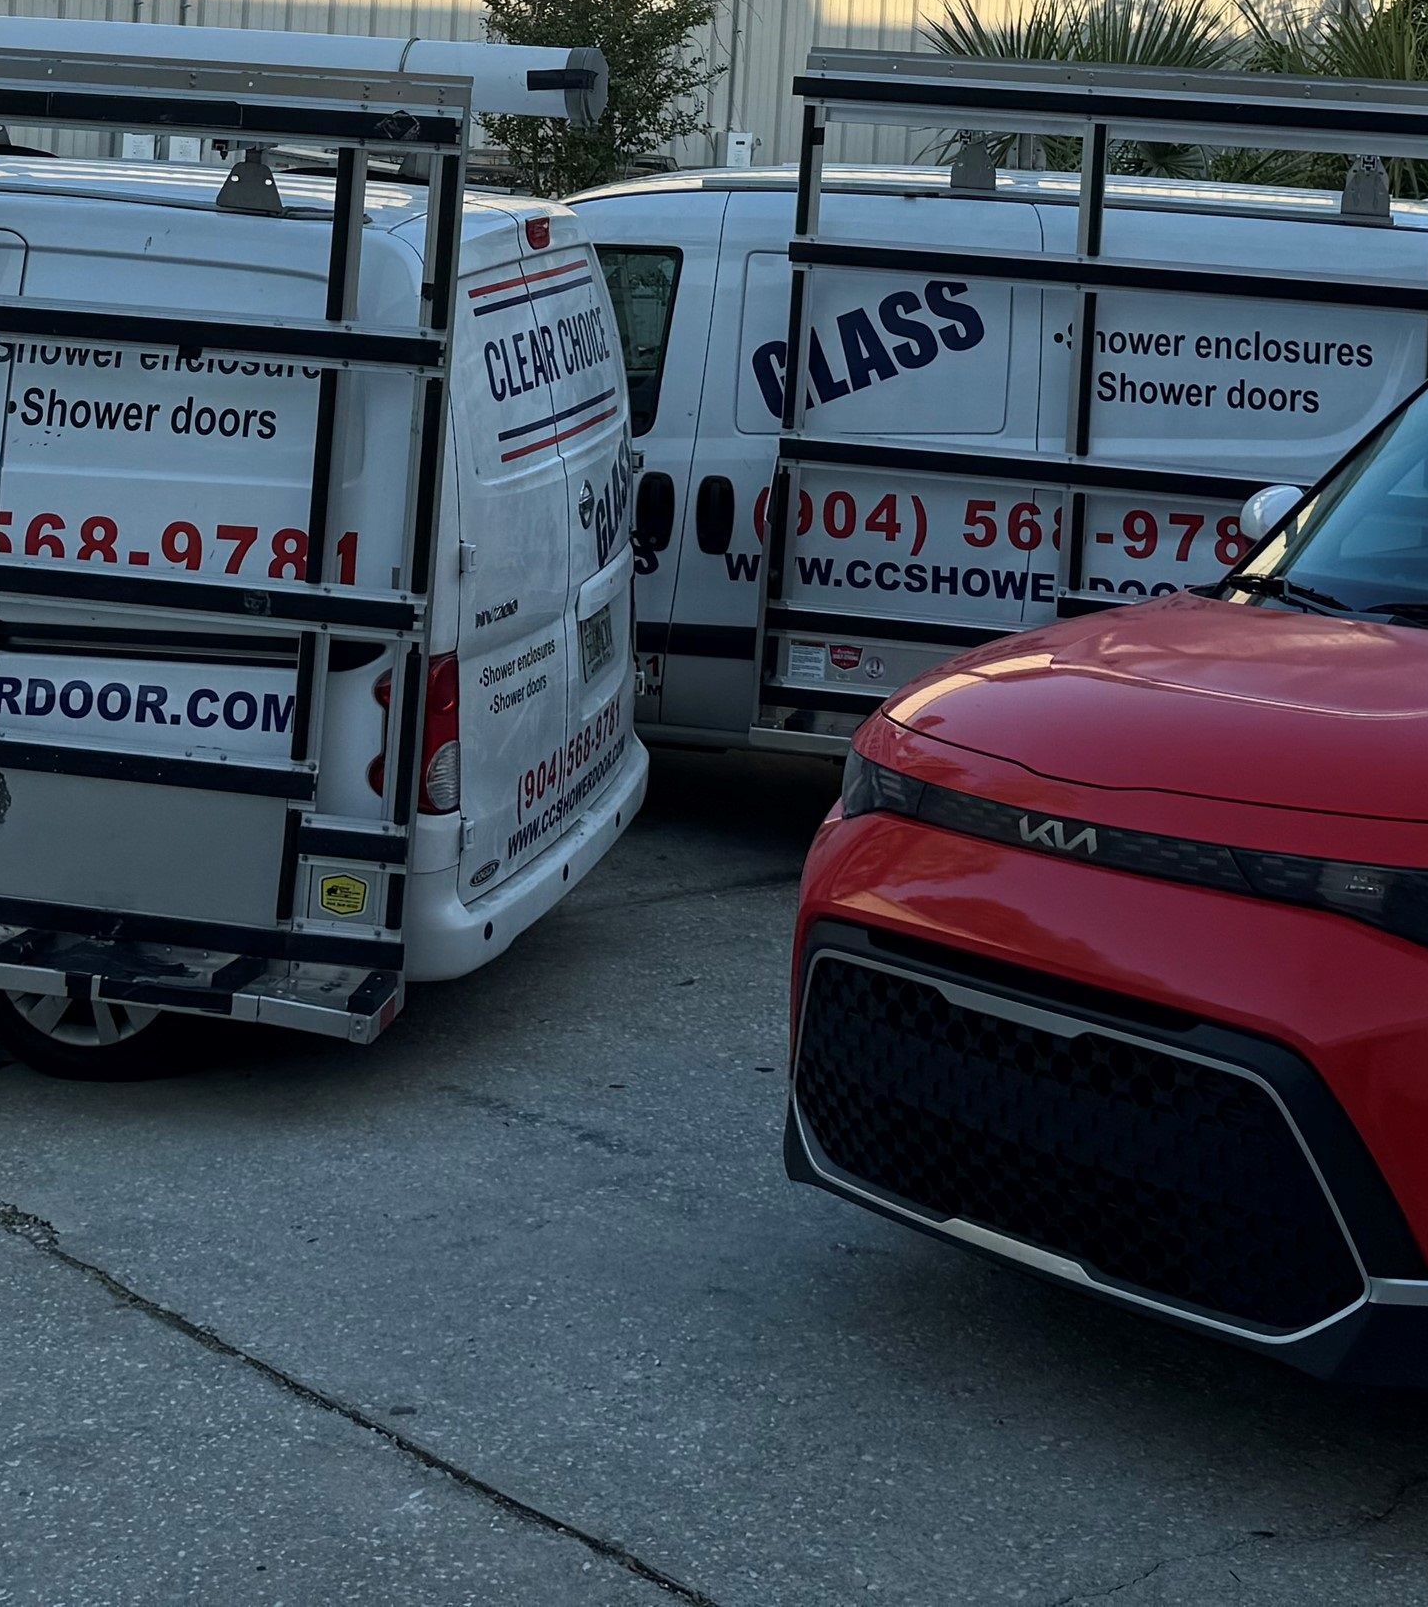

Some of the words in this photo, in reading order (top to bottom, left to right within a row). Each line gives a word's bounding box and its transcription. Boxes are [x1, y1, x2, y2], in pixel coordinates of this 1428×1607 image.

[484, 325, 561, 402] CLEAR
[557, 306, 610, 375] CHOICE
[1194, 330, 1374, 369] enclosures
[20, 387, 161, 433] Shower
[170, 396, 278, 440] doors
[1096, 370, 1217, 408] Shower
[1226, 378, 1320, 415] doors
[475, 598, 519, 629] NV200
[483, 657, 517, 688] Shower
[517, 639, 556, 672] enclosures
[493, 687, 526, 715] Shower
[526, 674, 548, 699] doors
[517, 746, 563, 825] (904)
[566, 693, 621, 778] 568-9781
[508, 733, 626, 860] WWW.CCSHOWERDOOR.COM
[1018, 814, 1098, 855] KIA
